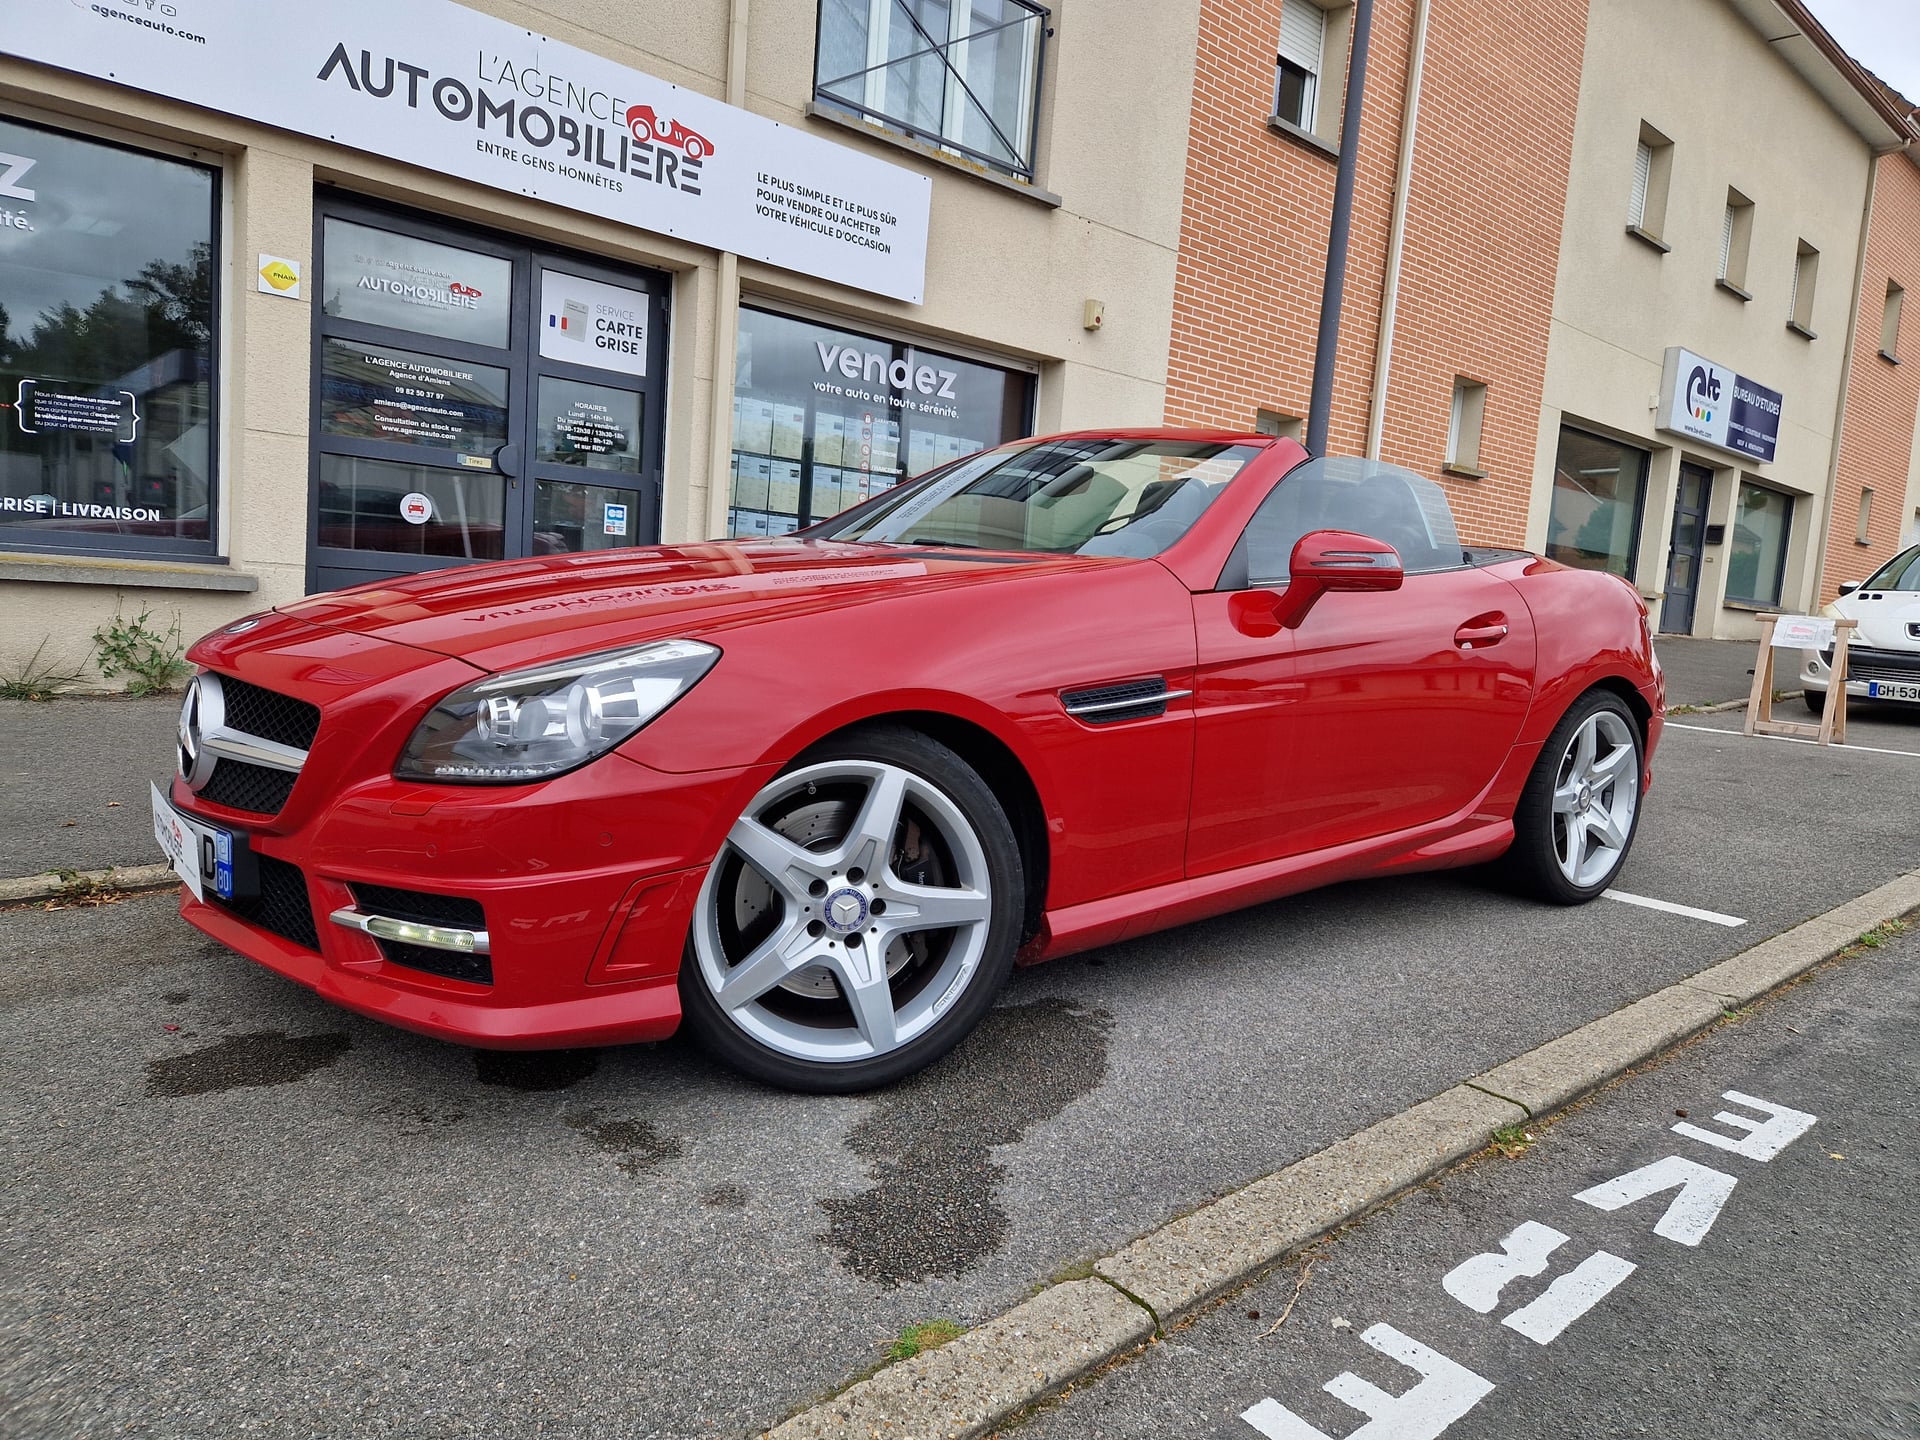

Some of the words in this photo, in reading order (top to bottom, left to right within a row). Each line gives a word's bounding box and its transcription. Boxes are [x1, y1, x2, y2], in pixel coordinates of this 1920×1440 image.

[91, 4, 206, 44] agenceauto.com
[478, 50, 627, 128] L'AGENCE
[317, 42, 703, 196] AUTOMOBILIERE
[476, 139, 518, 162] ENTRE
[521, 154, 555, 173] GENS
[558, 164, 623, 193] HONNÊTES
[758, 172, 768, 184] LE
[771, 177, 794, 192] PLUS
[796, 185, 830, 204] SIMPLE
[832, 195, 843, 208] ET
[845, 202, 855, 213] LE
[857, 206, 878, 220] PLUS
[880, 212, 897, 226] SÛR
[756, 188, 784, 206] POUR
[786, 197, 822, 218] VENDRE
[825, 211, 838, 222] OU
[840, 216, 880, 236] ACHETER
[756, 204, 787, 222] VOTRE
[789, 213, 834, 237] VÉHICULE
[836, 229, 891, 254] D'OCCASION
[273, 272, 297, 282] FNAIM
[596, 304, 634, 321] SERVICE
[596, 318, 642, 339] CARTE
[596, 335, 638, 355] GRISE
[365, 356, 407, 369] L'AGENCE
[409, 364, 473, 380] AUTOMOBILIERE
[390, 370, 416, 380] Agence
[418, 375, 451, 386] d'Amiens
[817, 343, 957, 399] vendez
[814, 382, 841, 394] votre
[845, 389, 870, 400] auto
[873, 394, 885, 404] en
[889, 396, 916, 410] toute
[919, 401, 959, 419] sérénité.
[1734, 386, 1755, 405] BUREAU
[374, 399, 464, 417] amiens@agenceauto.com
[575, 402, 607, 412] HORAIRES
[374, 415, 419, 427] Consultation
[382, 425, 456, 440] www.agenceauto.com
[567, 434, 588, 442] Samedi
[0, 497, 46, 514] RISE
[62, 502, 160, 521] LIVRAISON
[1878, 685, 1920, 699] GH-53
[200, 834, 216, 880] D
